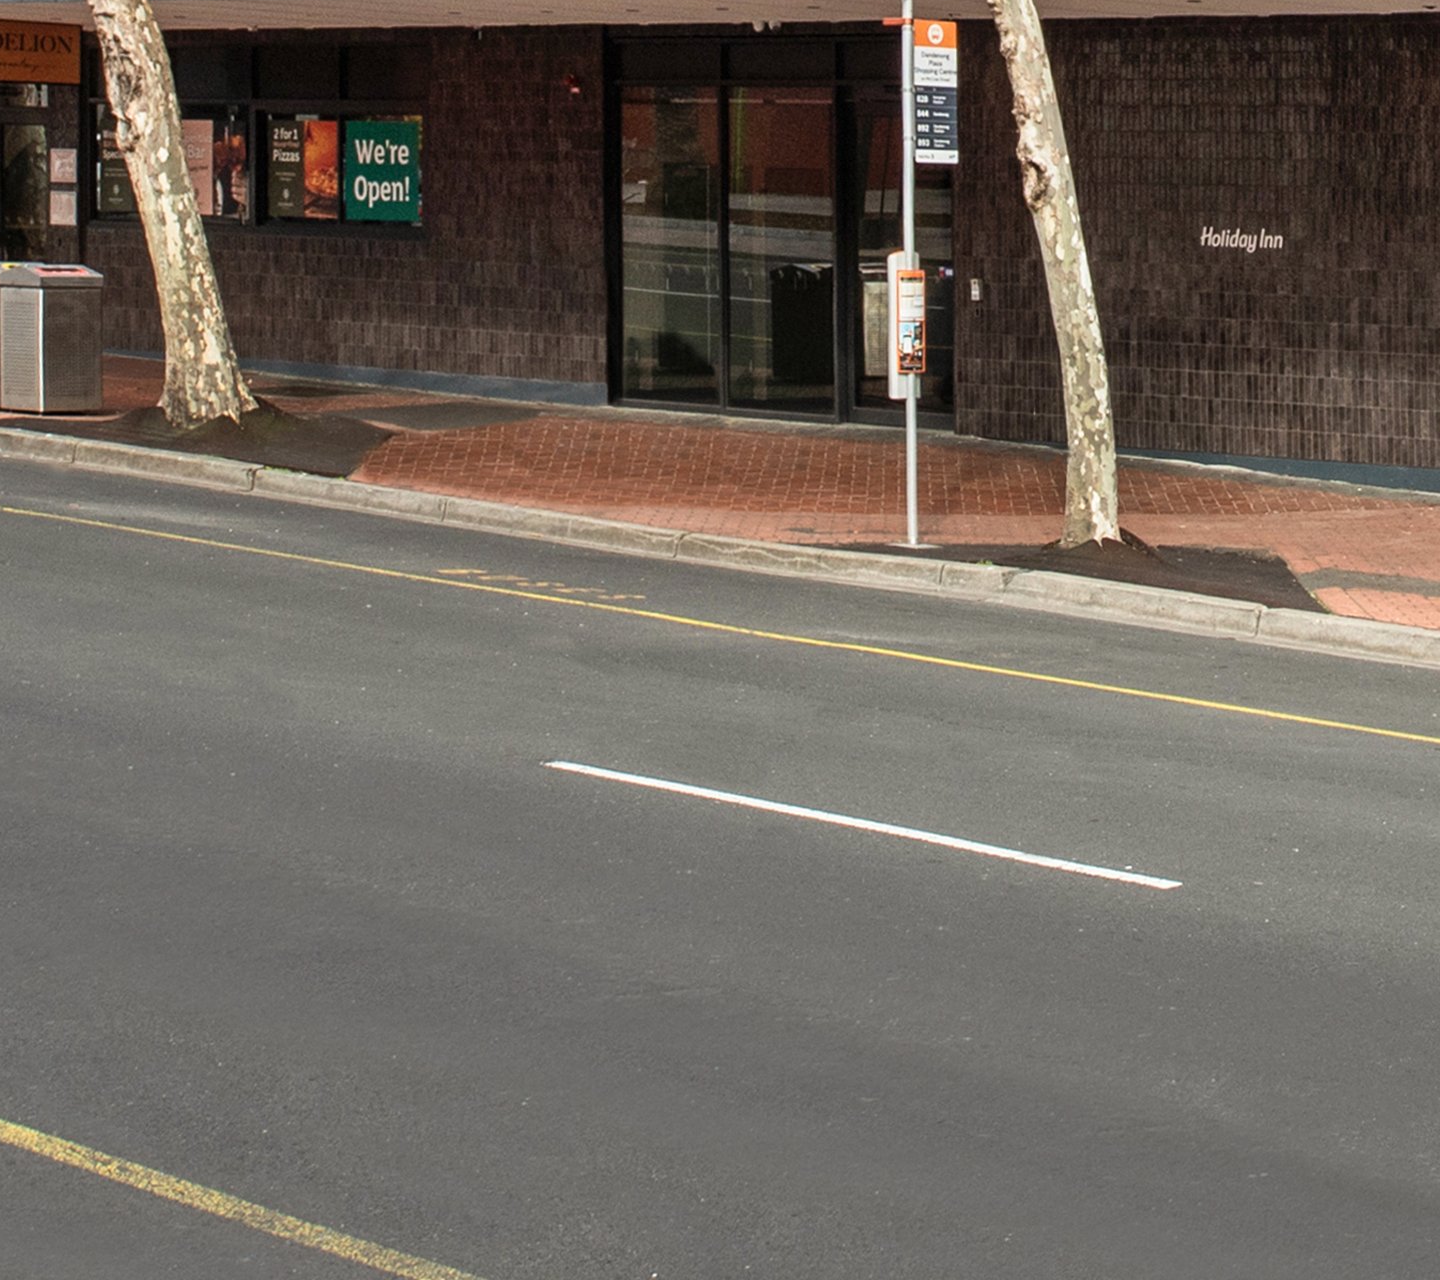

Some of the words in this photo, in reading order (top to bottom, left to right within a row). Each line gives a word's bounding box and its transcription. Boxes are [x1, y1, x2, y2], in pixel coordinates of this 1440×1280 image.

[273, 128, 279, 140] 2
[280, 127, 292, 140] for
[293, 128, 299, 140] 1
[272, 149, 300, 163] Pizzas
[354, 139, 409, 165] We're
[354, 175, 410, 208] Open!
[1200, 226, 1258, 254] Holiday
[1259, 228, 1284, 249] Inn
